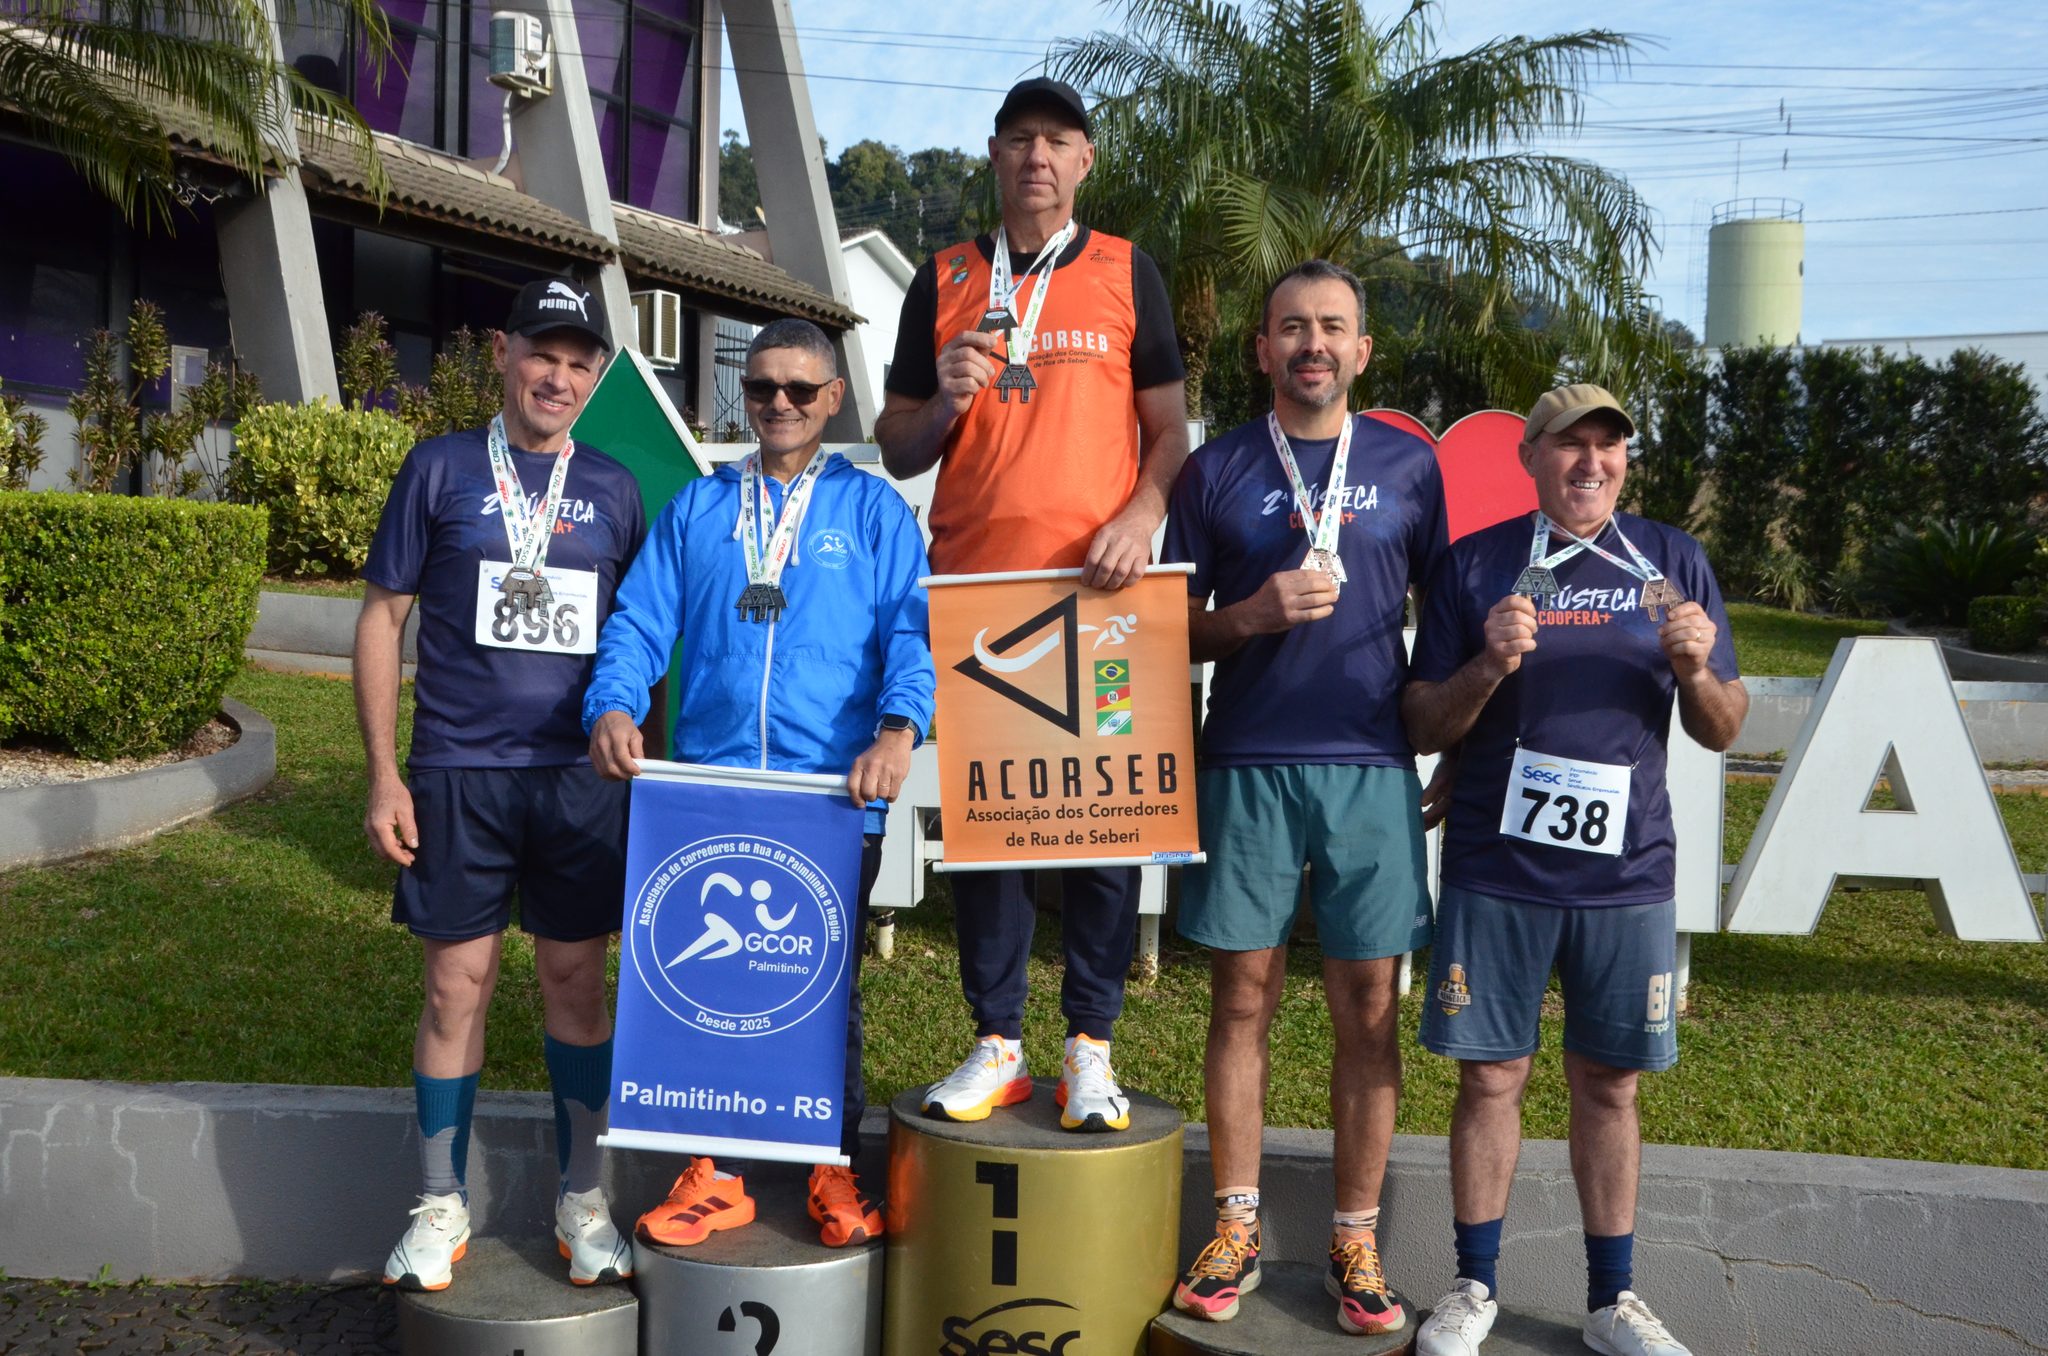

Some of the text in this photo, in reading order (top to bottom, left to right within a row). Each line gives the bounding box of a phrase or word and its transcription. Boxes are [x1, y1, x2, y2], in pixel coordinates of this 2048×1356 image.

[539, 299, 576, 311] PUMA
[1028, 330, 1108, 352] CORSEB
[518, 533, 534, 566] CRESOL
[492, 597, 580, 648] 896
[1538, 610, 1614, 626] COOPERA+
[968, 752, 1178, 802] ACORSEB
[966, 801, 1179, 825] Associação dos Corredores
[1522, 787, 1610, 847] 738
[1006, 828, 1140, 847] de Rua de Seberi
[639, 842, 842, 942] Associação de Corredores de Rua de Palmitinho e Região
[744, 932, 813, 956] GCOR
[748, 960, 810, 975] Palmitinho
[695, 1010, 772, 1032] Desde 2025
[620, 1080, 767, 1116] Palmitinho
[794, 1096, 832, 1120] RS
[976, 1161, 1018, 1286] 1
